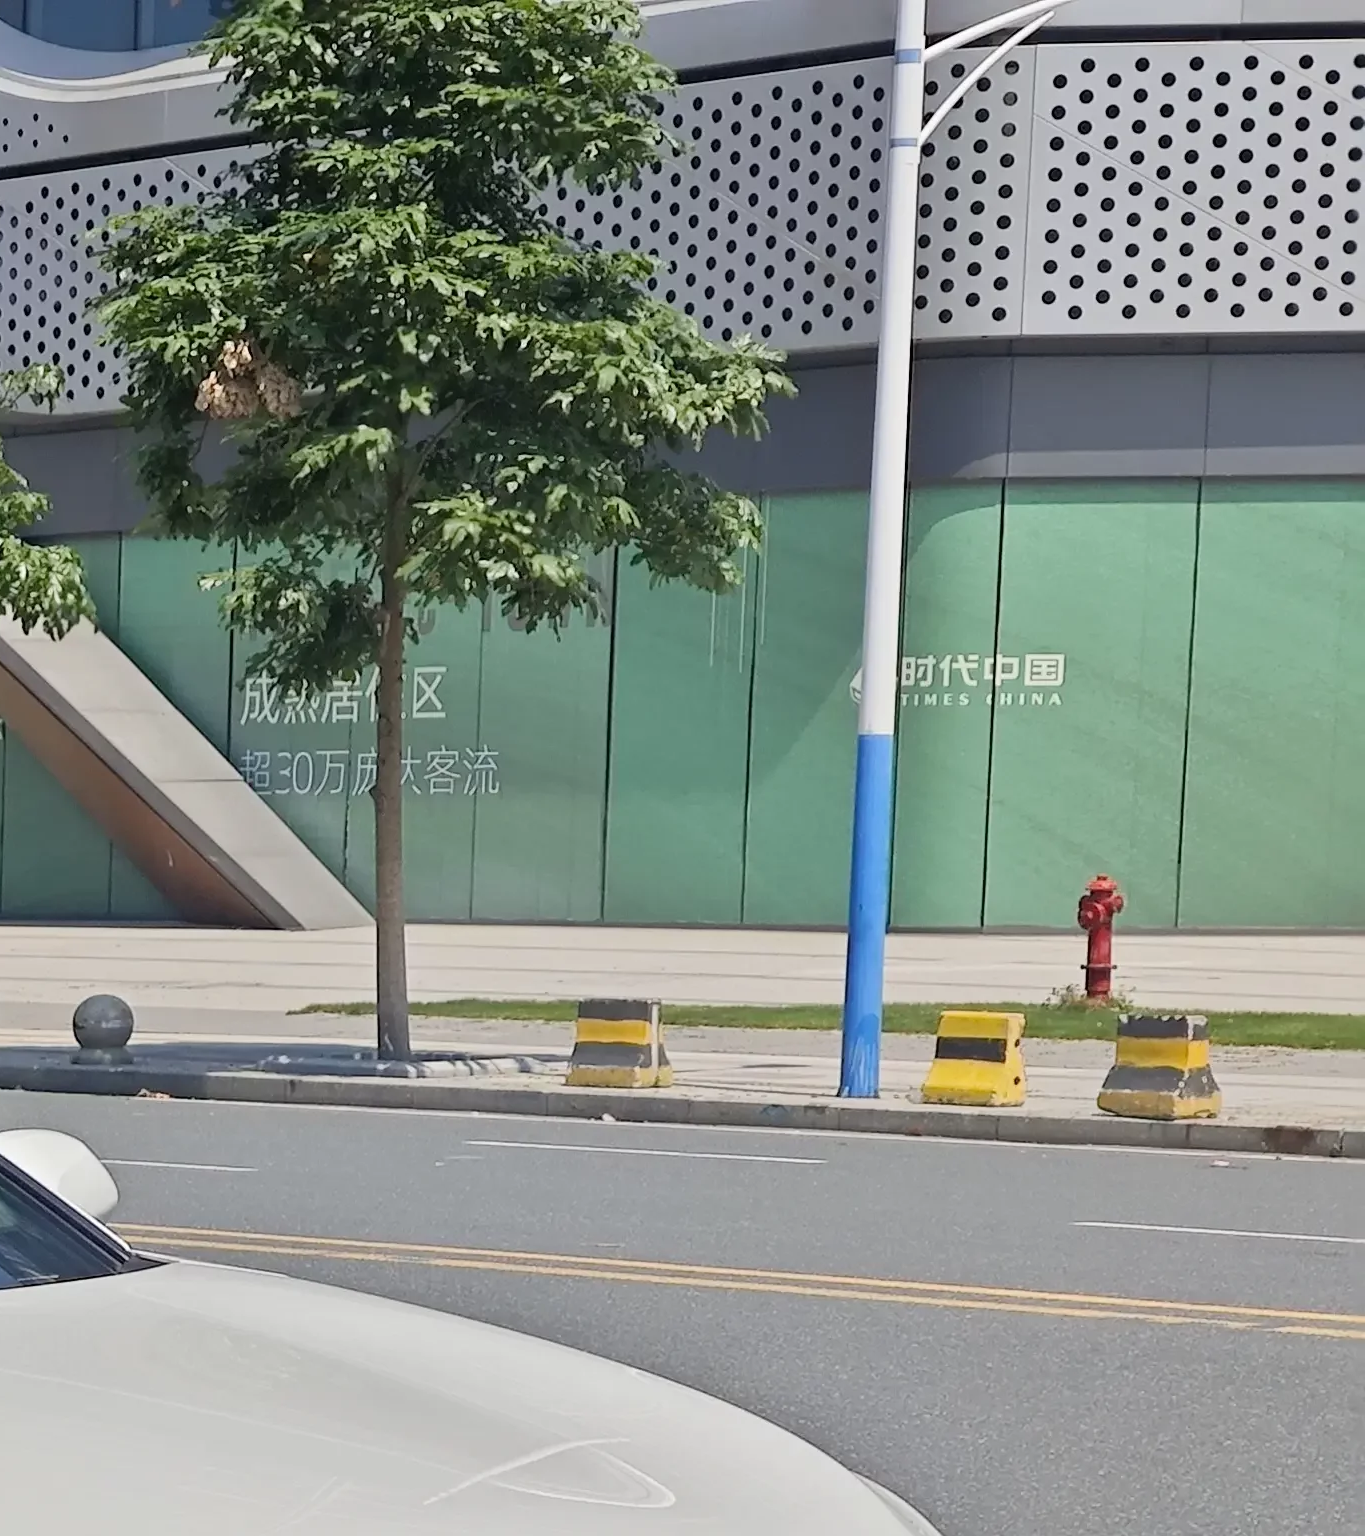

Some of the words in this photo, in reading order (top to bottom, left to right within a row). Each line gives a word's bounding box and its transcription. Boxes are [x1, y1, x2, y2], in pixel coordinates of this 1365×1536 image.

[900, 652, 1066, 688] 时代中国
[900, 692, 971, 707] TIMES
